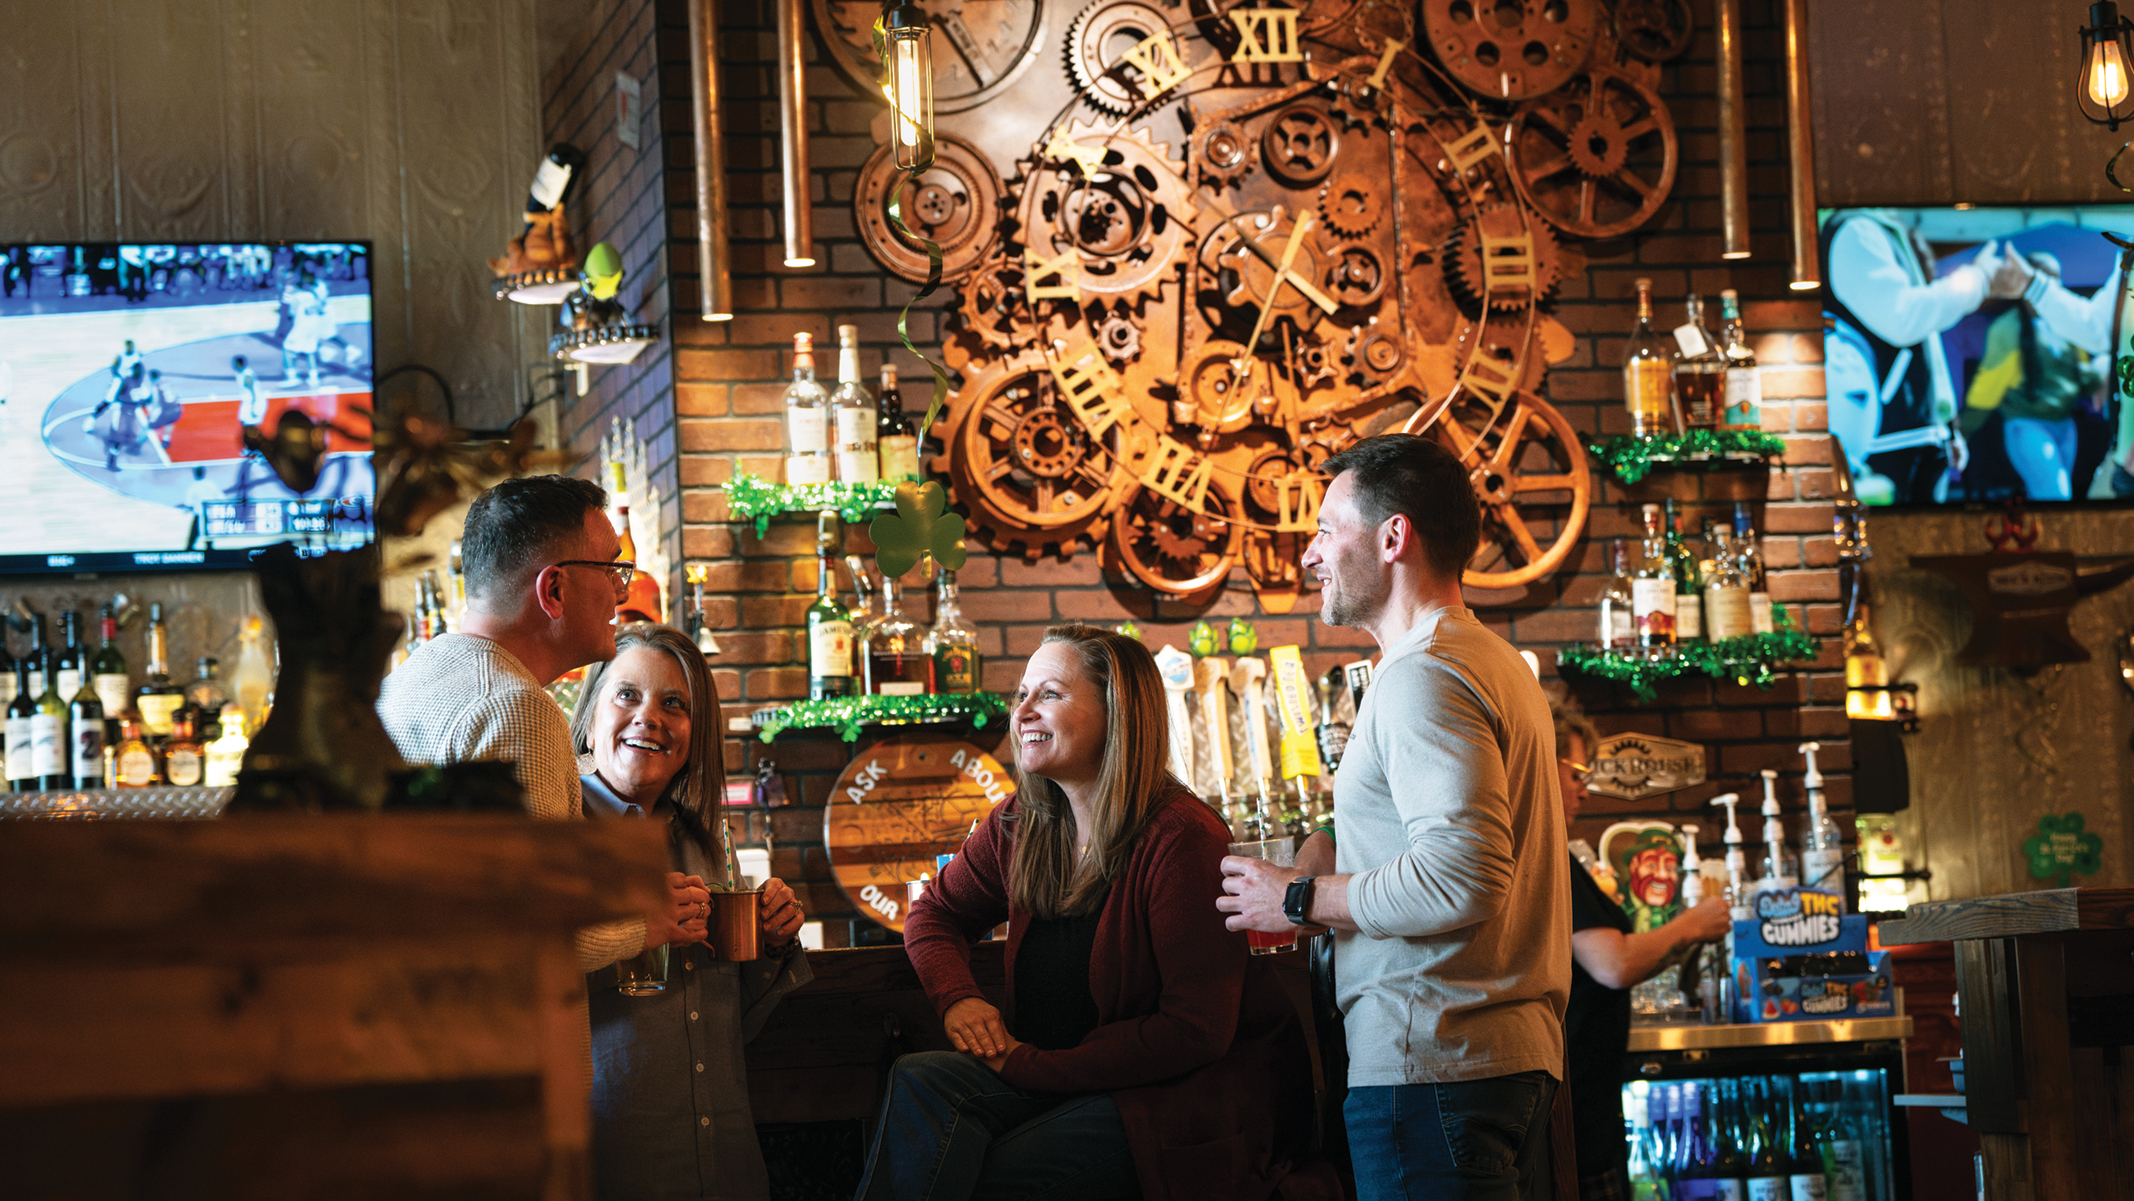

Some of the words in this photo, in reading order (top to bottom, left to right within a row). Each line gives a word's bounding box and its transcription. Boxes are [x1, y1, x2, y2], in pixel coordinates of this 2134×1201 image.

[1229, 9, 1303, 62] XII
[1122, 29, 1193, 100] XI
[846, 759, 888, 805] ASK
[950, 749, 1007, 804] ABOU
[860, 884, 899, 921] OUR
[1800, 892, 1839, 916] THC
[1762, 914, 1839, 946] GUMMIES
